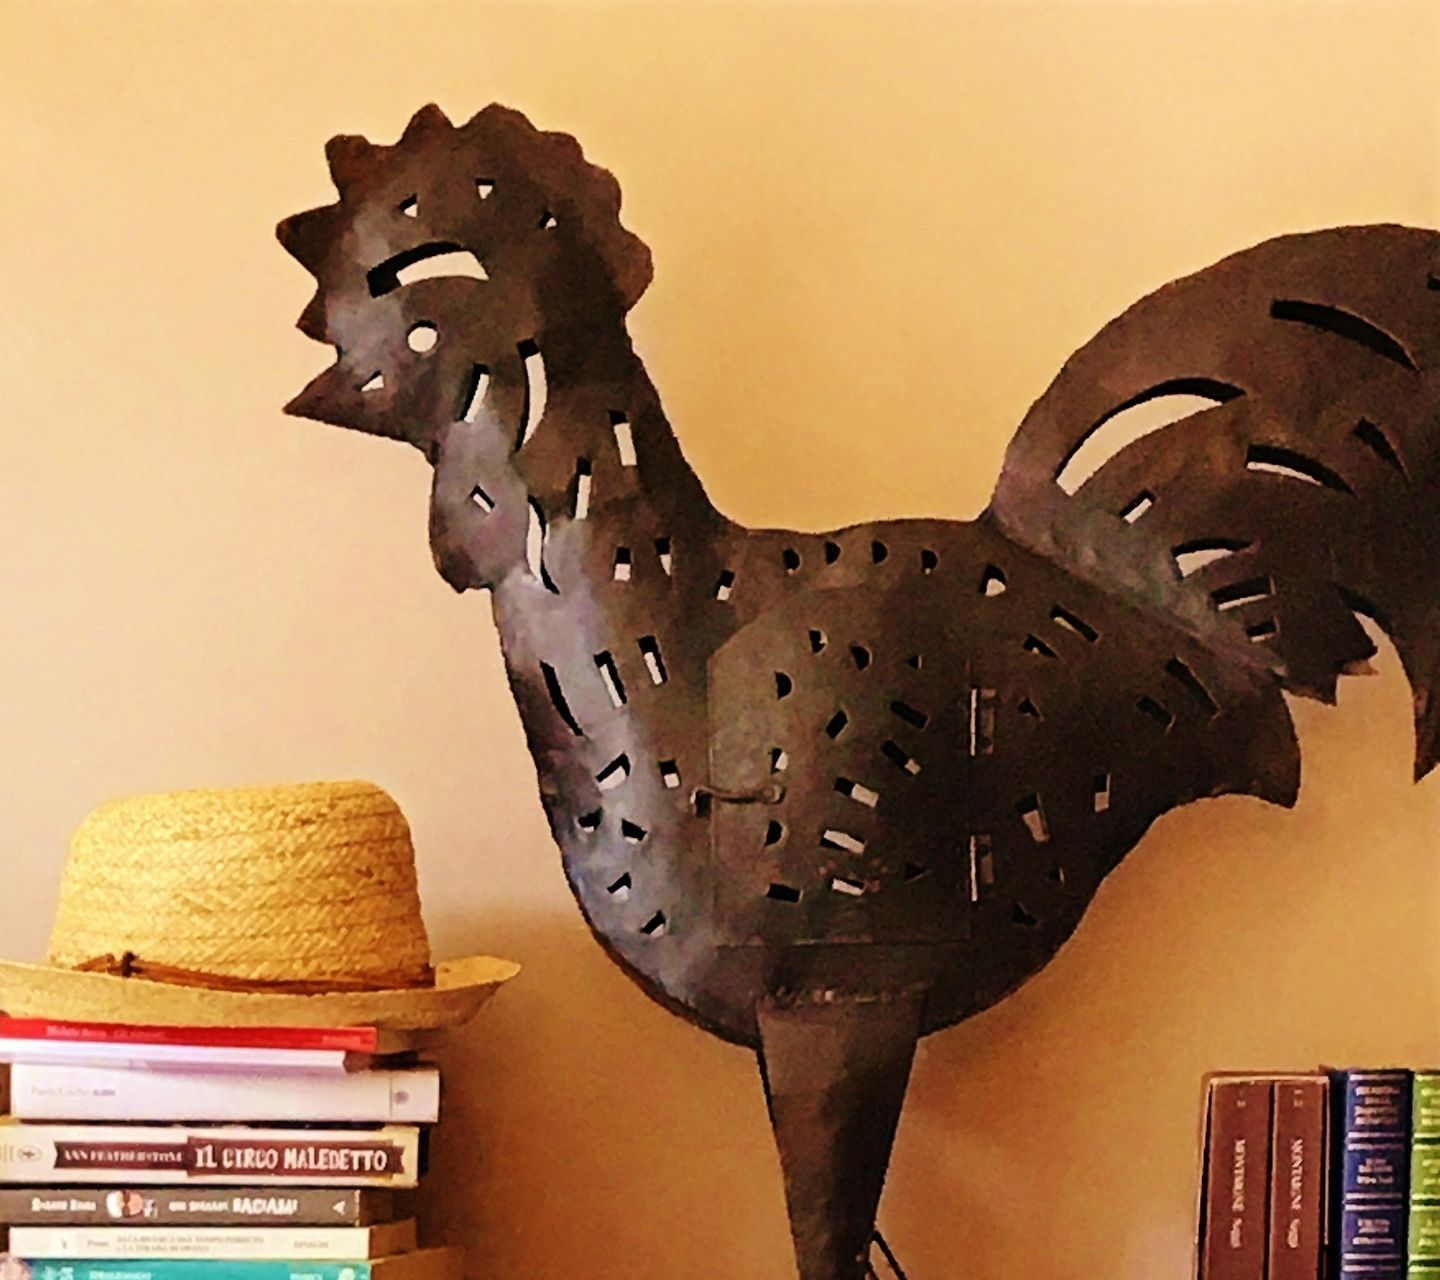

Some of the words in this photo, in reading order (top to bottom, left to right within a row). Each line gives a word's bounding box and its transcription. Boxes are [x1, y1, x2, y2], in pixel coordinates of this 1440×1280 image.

[194, 1144, 218, 1168] IL
[222, 1146, 279, 1170] CIRCO
[283, 1146, 389, 1172] MALEDETTO
